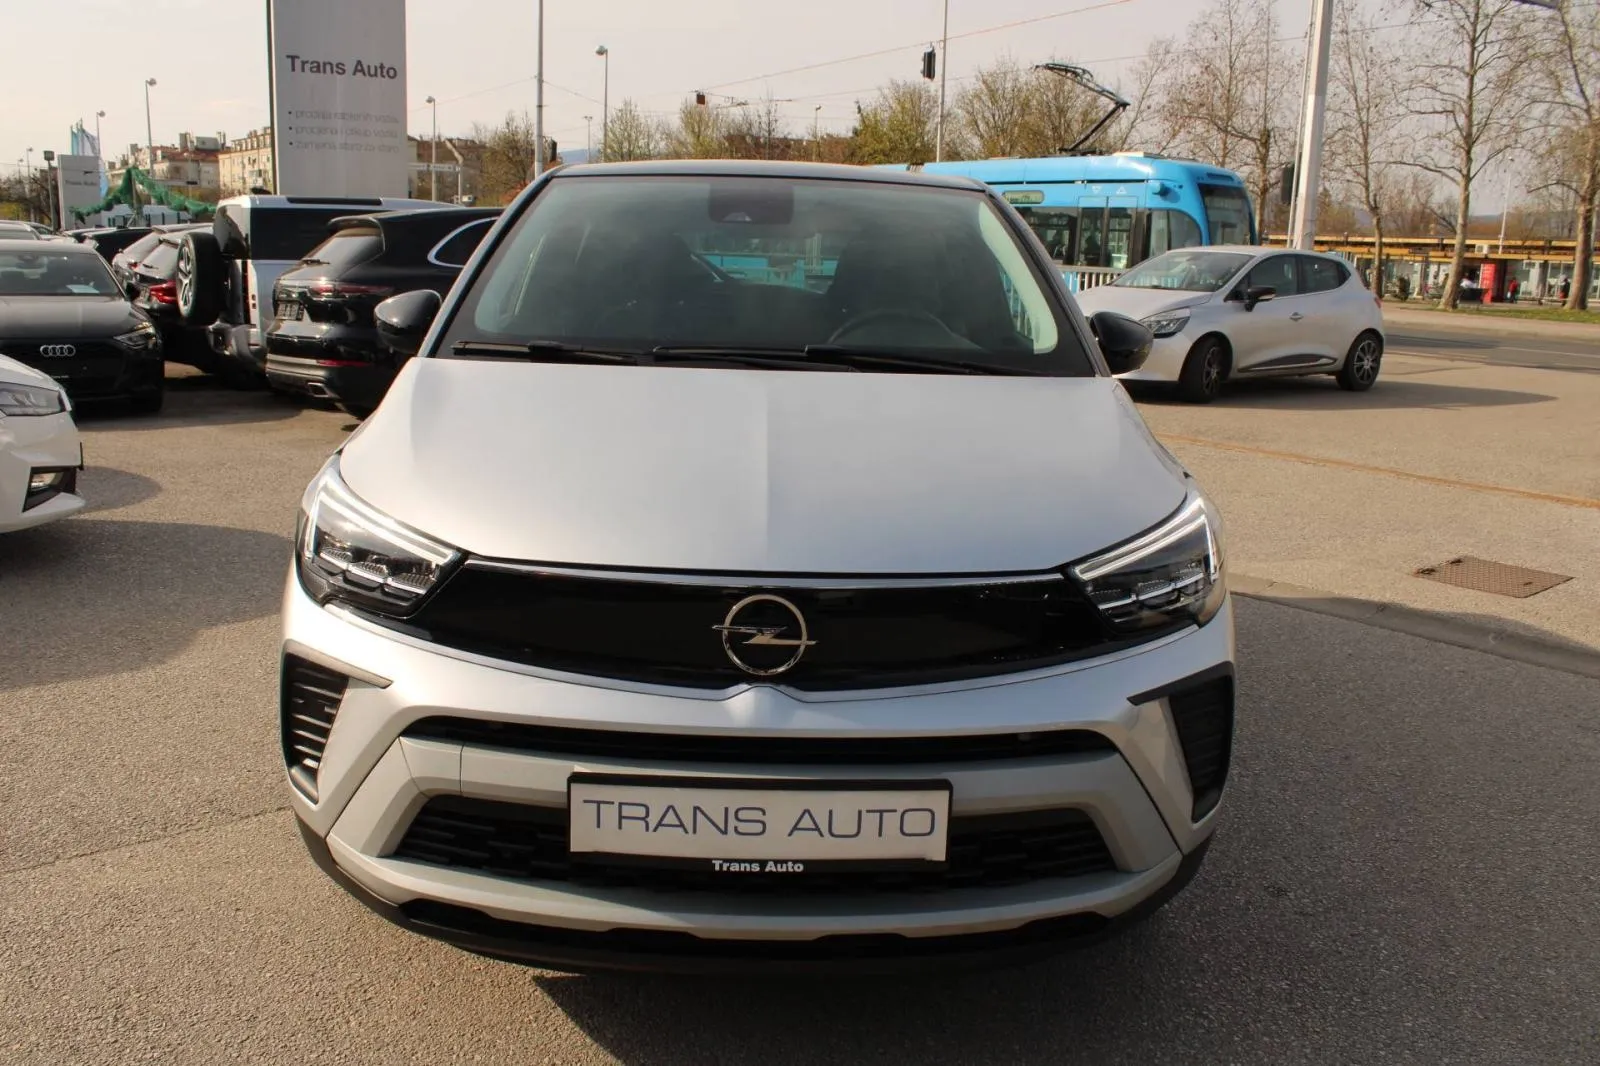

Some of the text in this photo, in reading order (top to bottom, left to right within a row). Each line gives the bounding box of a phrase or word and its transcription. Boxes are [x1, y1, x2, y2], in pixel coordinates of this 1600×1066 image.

[286, 55, 398, 79] Trans Auto
[583, 799, 935, 838] TRANS AUTO
[712, 860, 804, 872] Trans Auto
